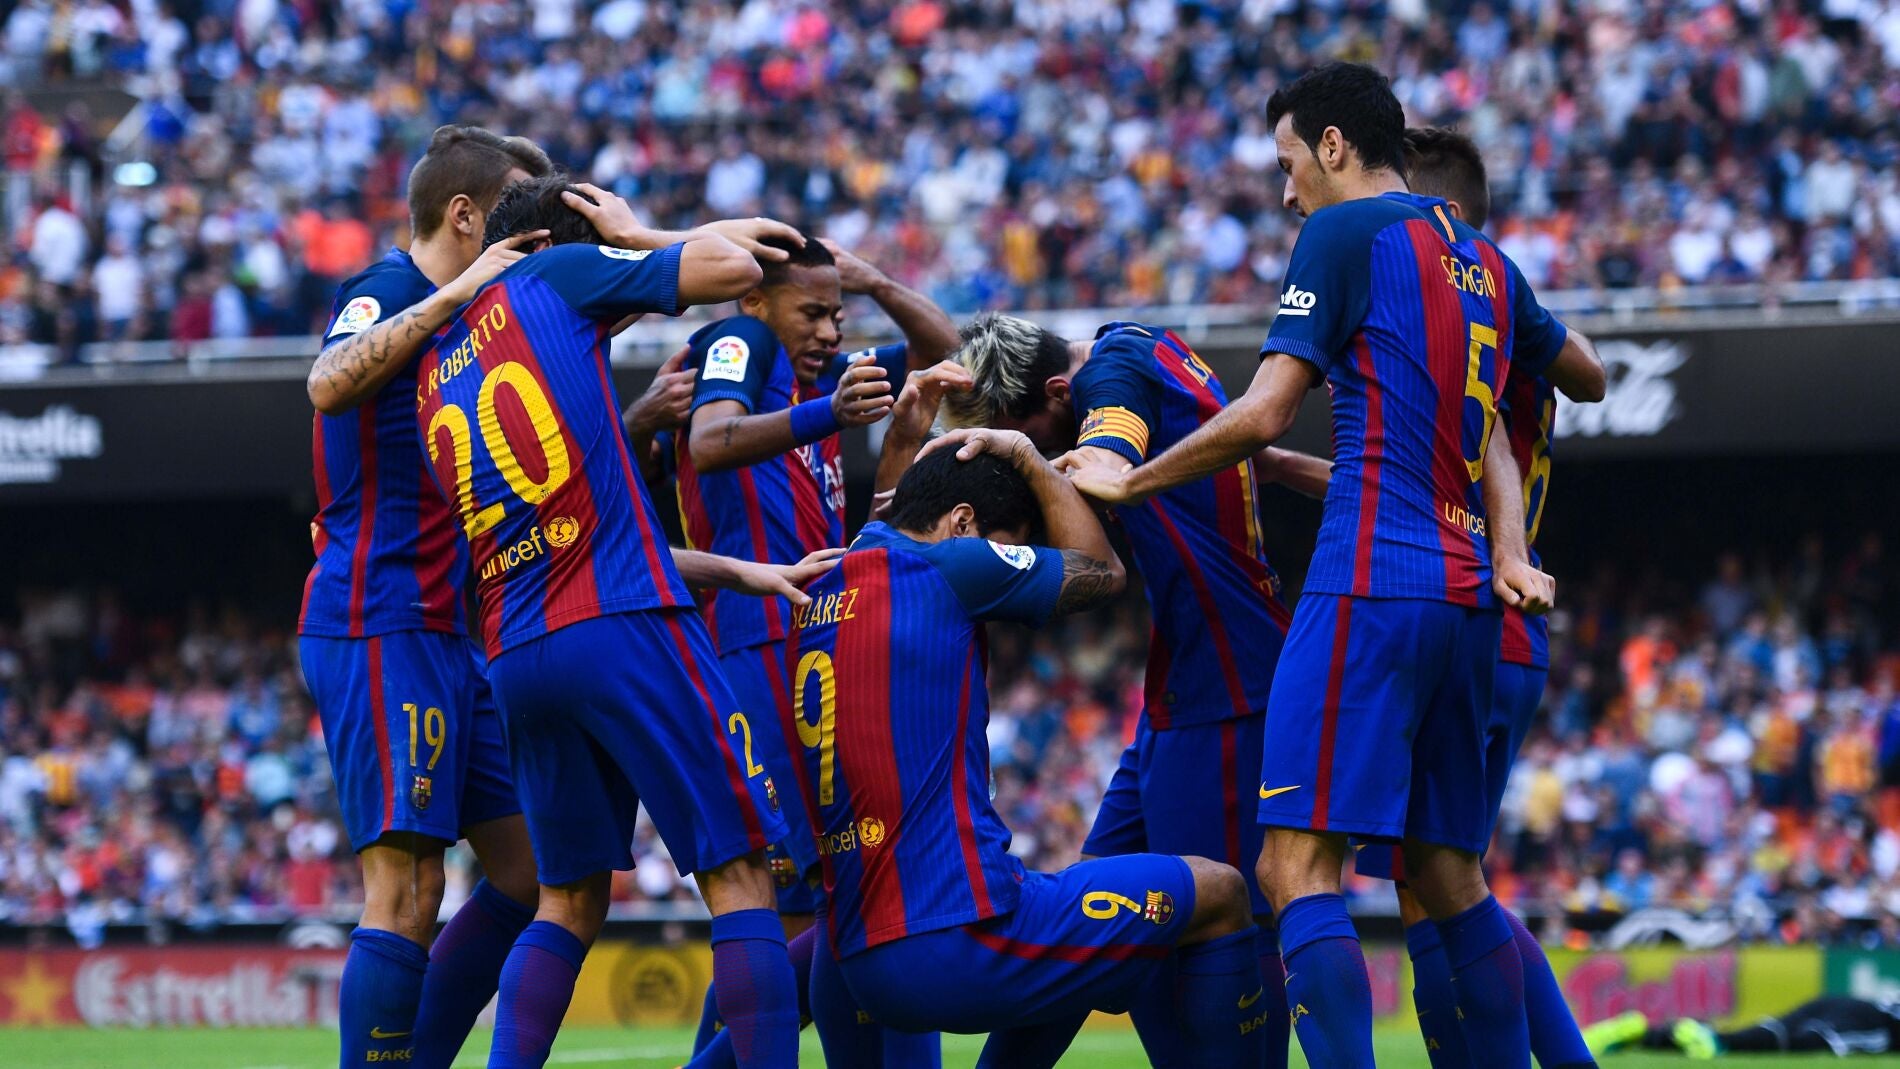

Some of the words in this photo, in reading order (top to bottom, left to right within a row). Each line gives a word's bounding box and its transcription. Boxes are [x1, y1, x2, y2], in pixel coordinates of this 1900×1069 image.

[428, 303, 507, 397] ROBERTO
[1464, 321, 1498, 484] 5
[428, 360, 571, 542] 20
[482, 527, 544, 580] unicef
[1445, 502, 1487, 537] unice
[403, 703, 446, 770] 19
[728, 712, 764, 778] 2
[794, 650, 836, 806] 9
